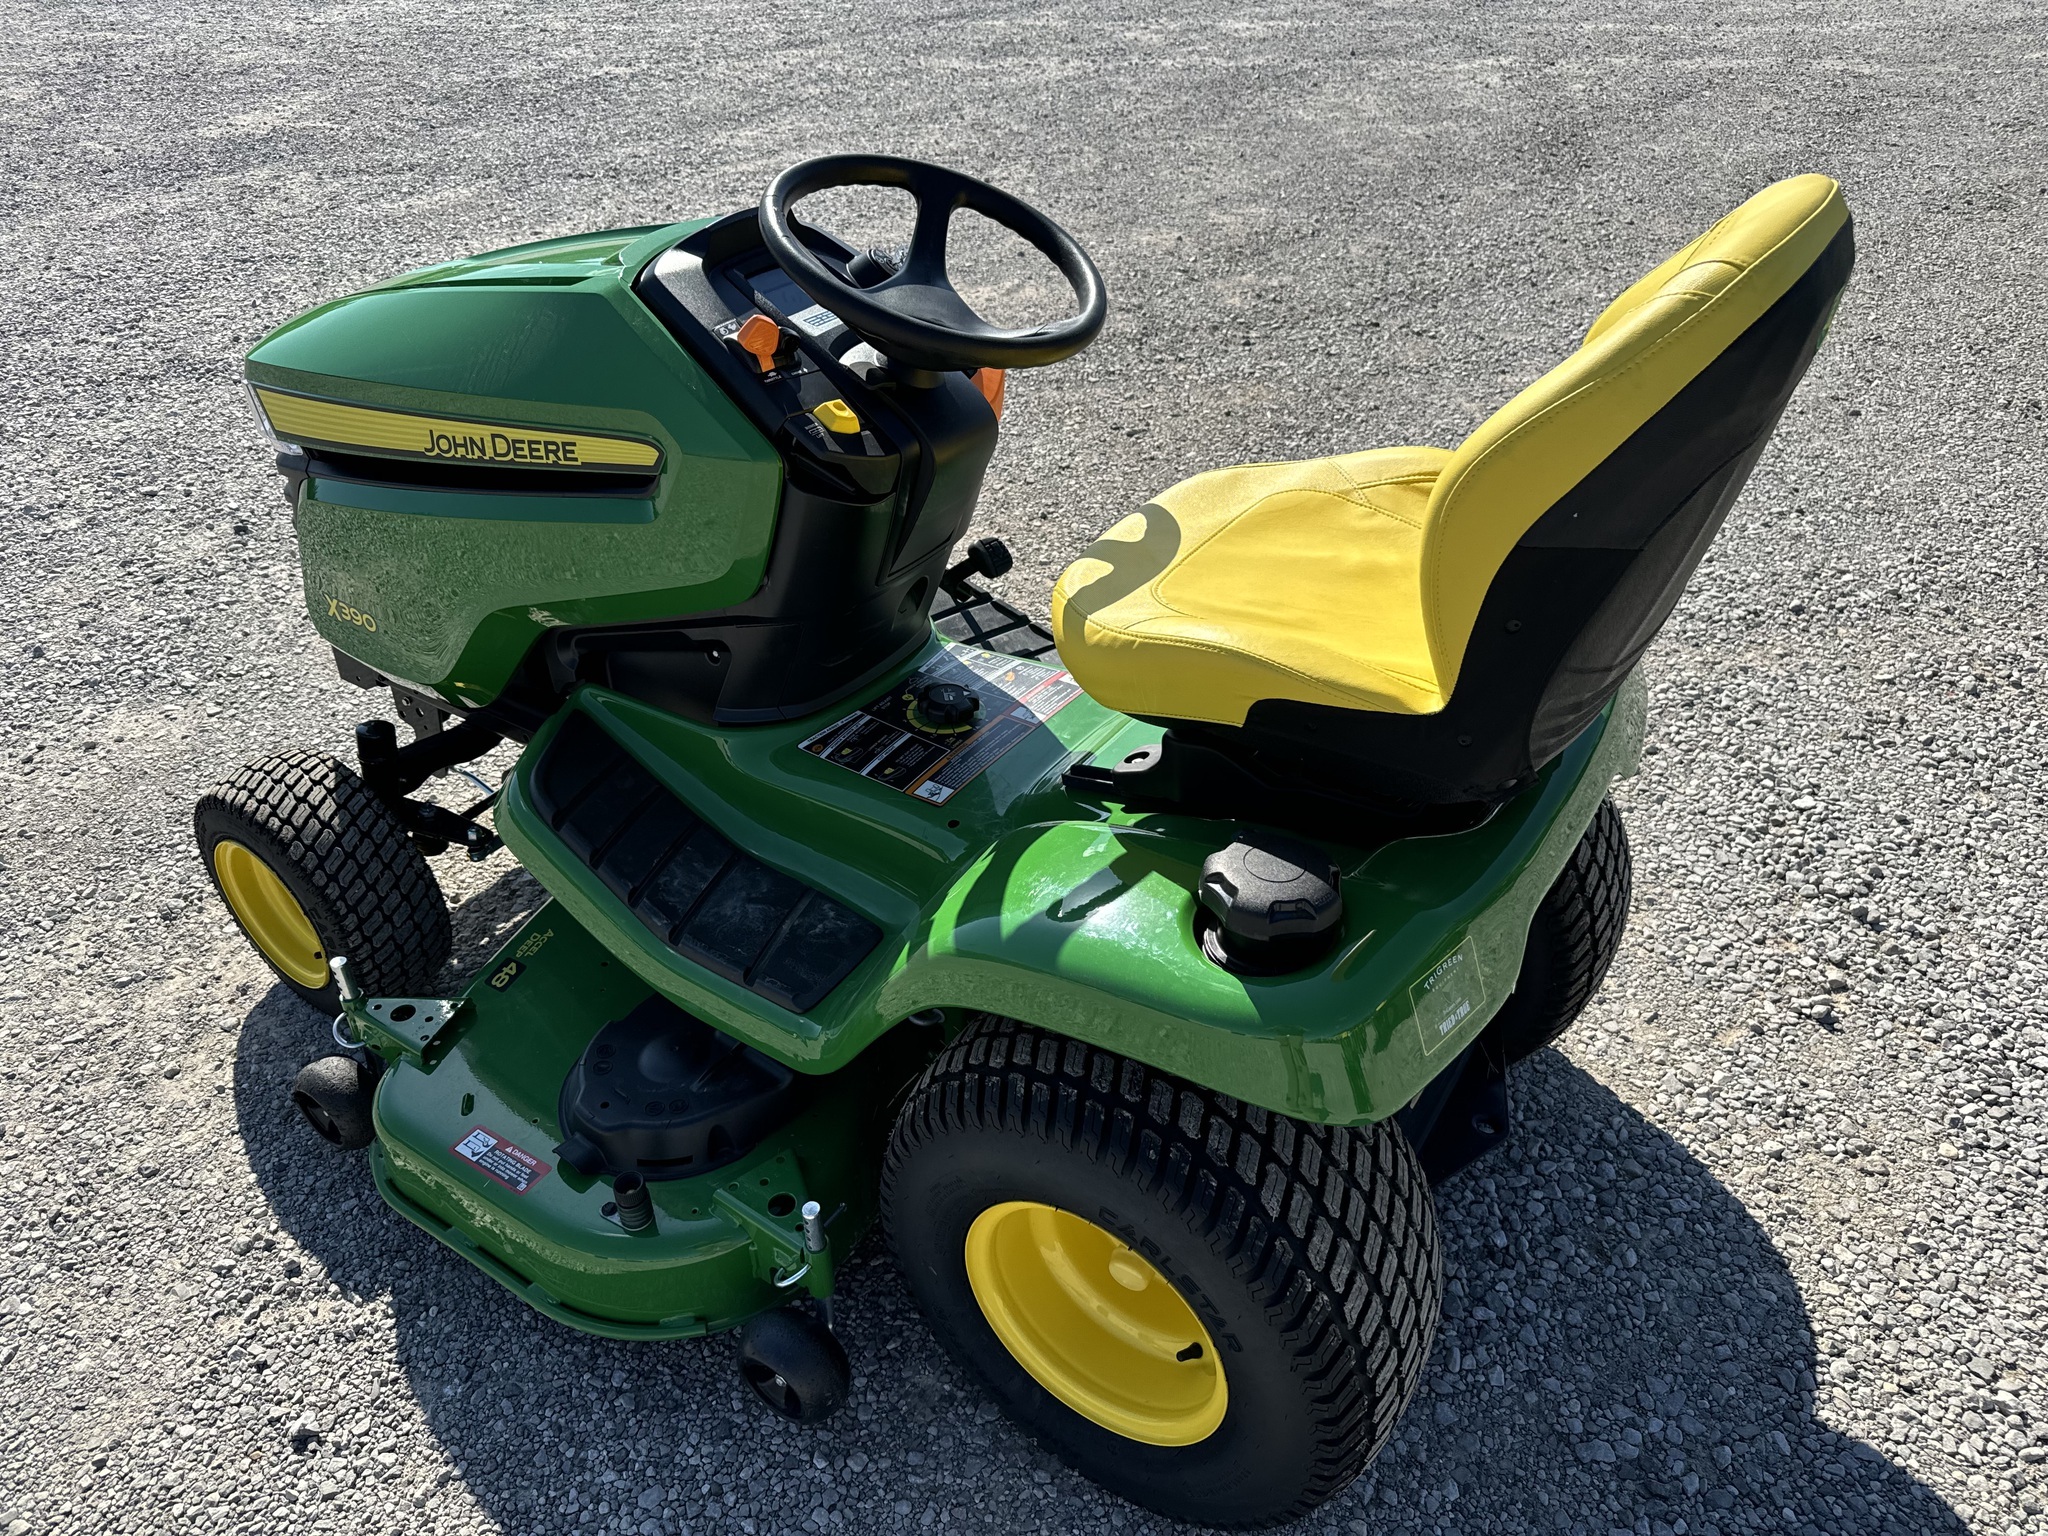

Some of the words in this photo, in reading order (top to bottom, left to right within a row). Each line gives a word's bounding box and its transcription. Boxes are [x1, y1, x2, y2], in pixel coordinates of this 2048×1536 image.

[424, 429, 486, 459] JOHN
[491, 433, 580, 463] DEERE
[322, 591, 377, 633] X390
[515, 932, 542, 958] DEEP
[524, 928, 555, 957] ACCEL
[491, 961, 517, 988] 48
[494, 1150, 518, 1165] ROTATING
[515, 1163, 532, 1174] BLADE
[511, 1149, 538, 1167] DANGER
[1098, 1205, 1244, 1353] CARLSTAR
